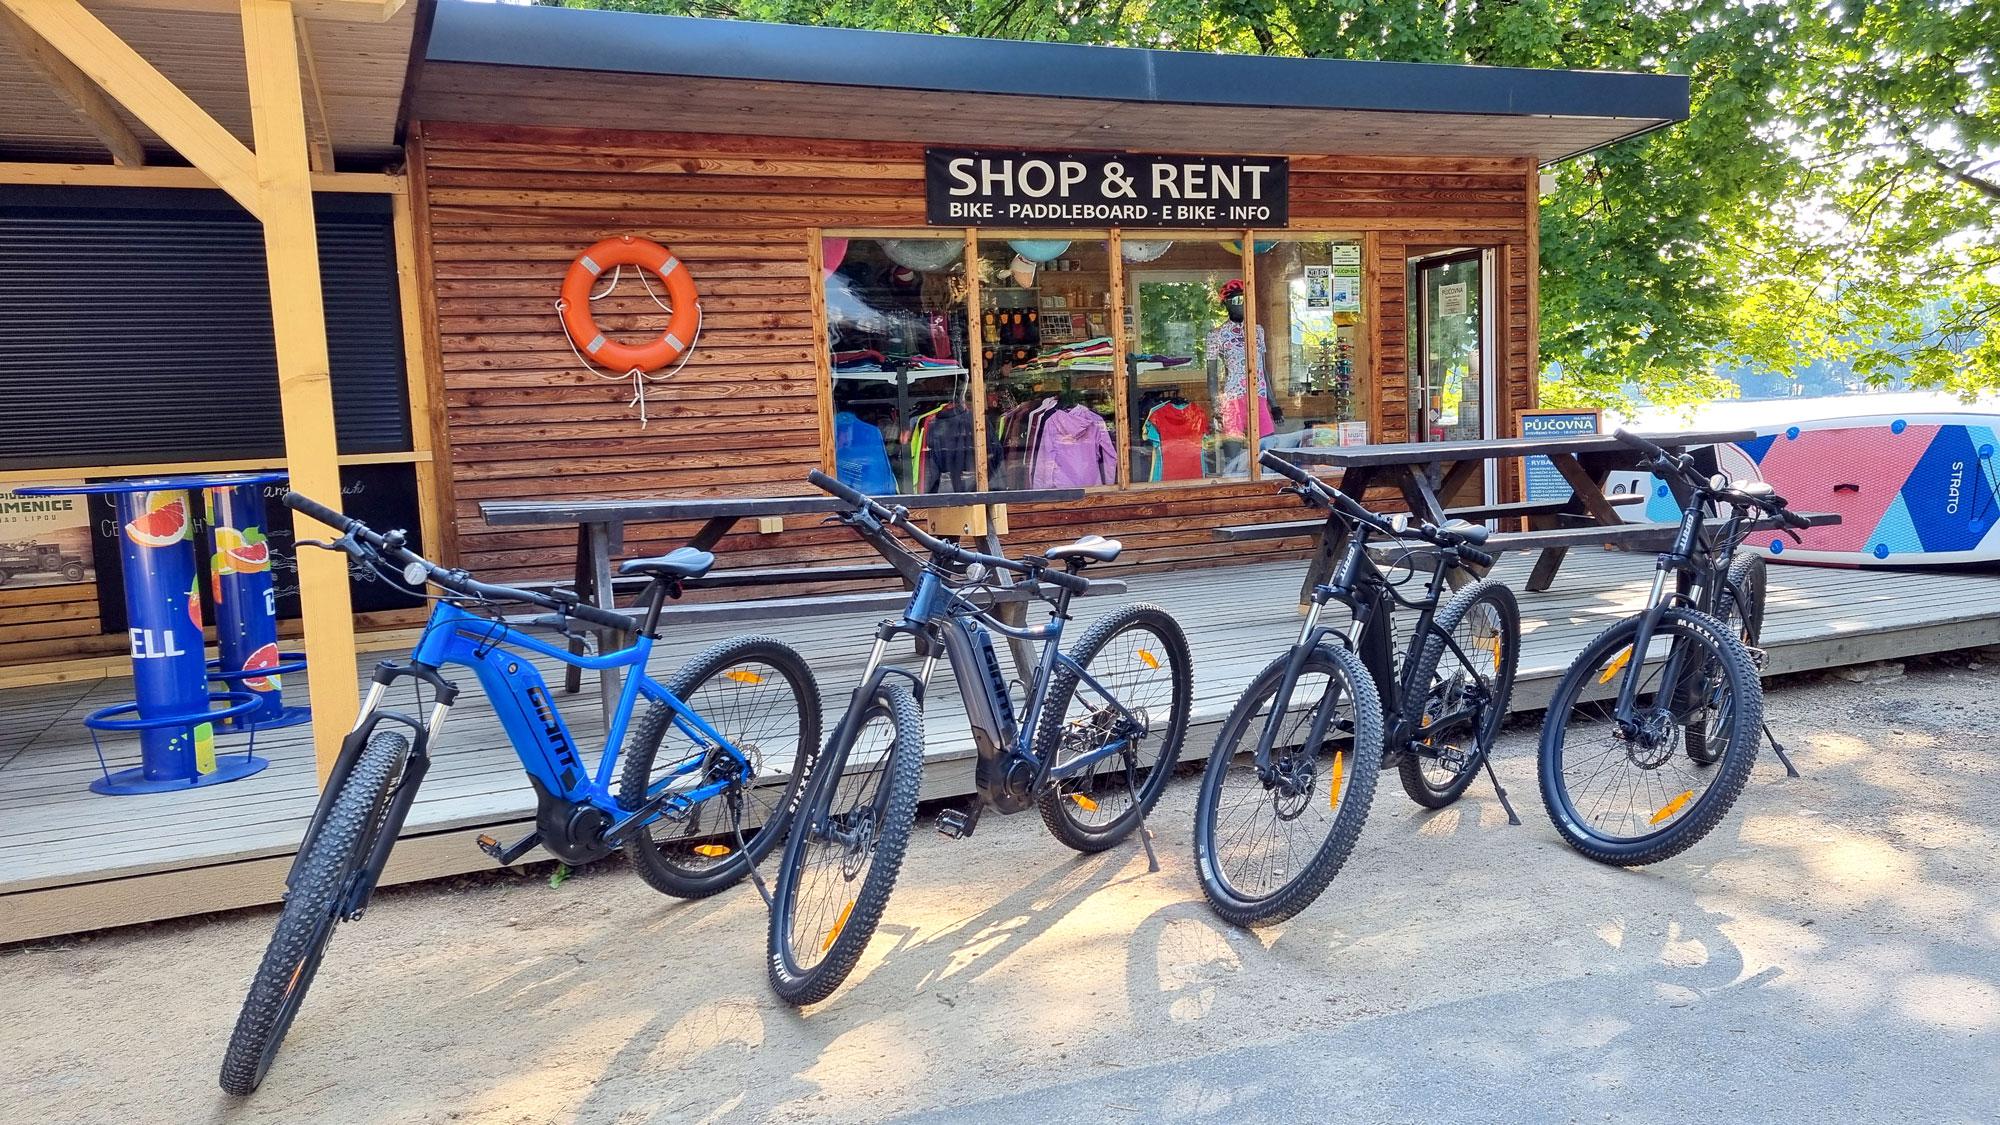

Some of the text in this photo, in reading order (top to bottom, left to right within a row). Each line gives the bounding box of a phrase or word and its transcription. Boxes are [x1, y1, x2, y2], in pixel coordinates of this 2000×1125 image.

[949, 158, 1270, 200] SHOP & RENT
[950, 202, 993, 218] BIKE
[1009, 203, 1148, 219] PADDLEBOARD
[1162, 205, 1173, 220] E
[1177, 205, 1216, 220] BIKE
[1229, 206, 1270, 220] INFO
[1524, 418, 1594, 431] PŮJČOVNA
[1947, 461, 1964, 514] STRATO
[1680, 513, 1694, 551] GIANT
[129, 627, 186, 659] ELL
[1677, 618, 1720, 648] MAXXIS
[526, 687, 579, 769] GIANT
[789, 753, 814, 814] MAXXIS
